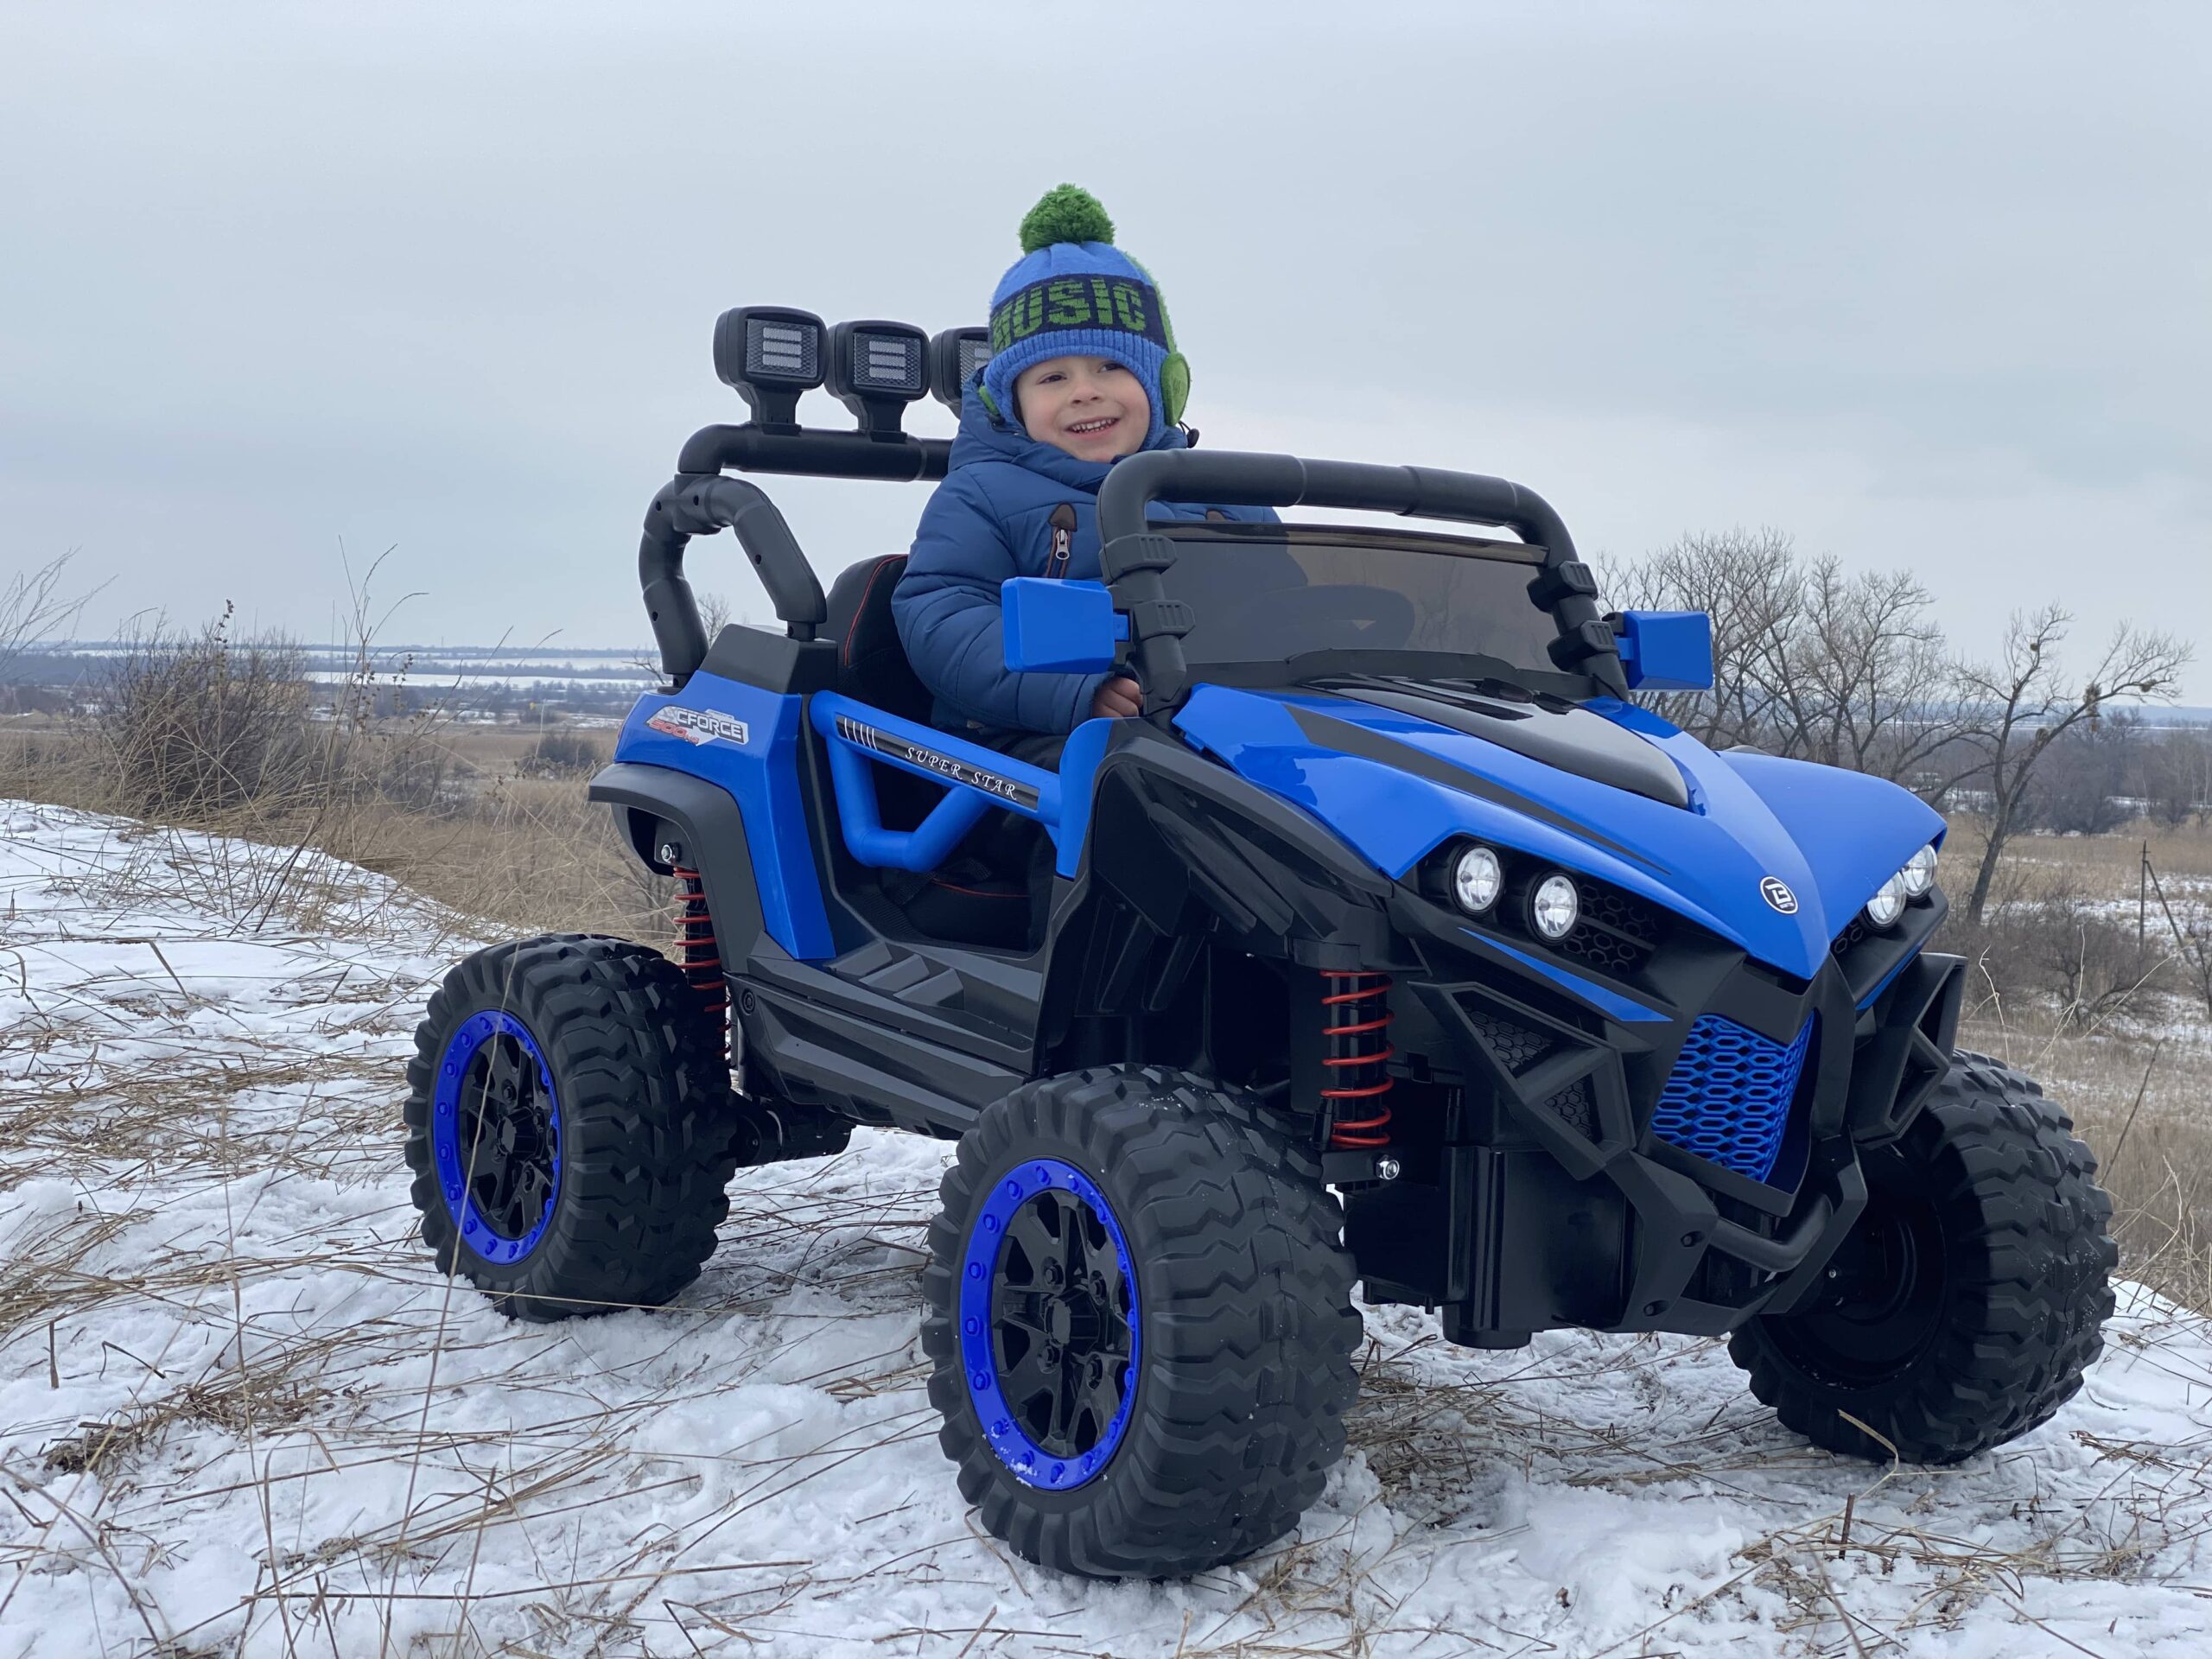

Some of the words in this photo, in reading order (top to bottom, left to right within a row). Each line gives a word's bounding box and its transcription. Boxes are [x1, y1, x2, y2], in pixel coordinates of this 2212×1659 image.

[677, 709, 743, 740] CFORCE
[905, 747, 963, 779] SUPER
[971, 772, 1017, 801] STAR
